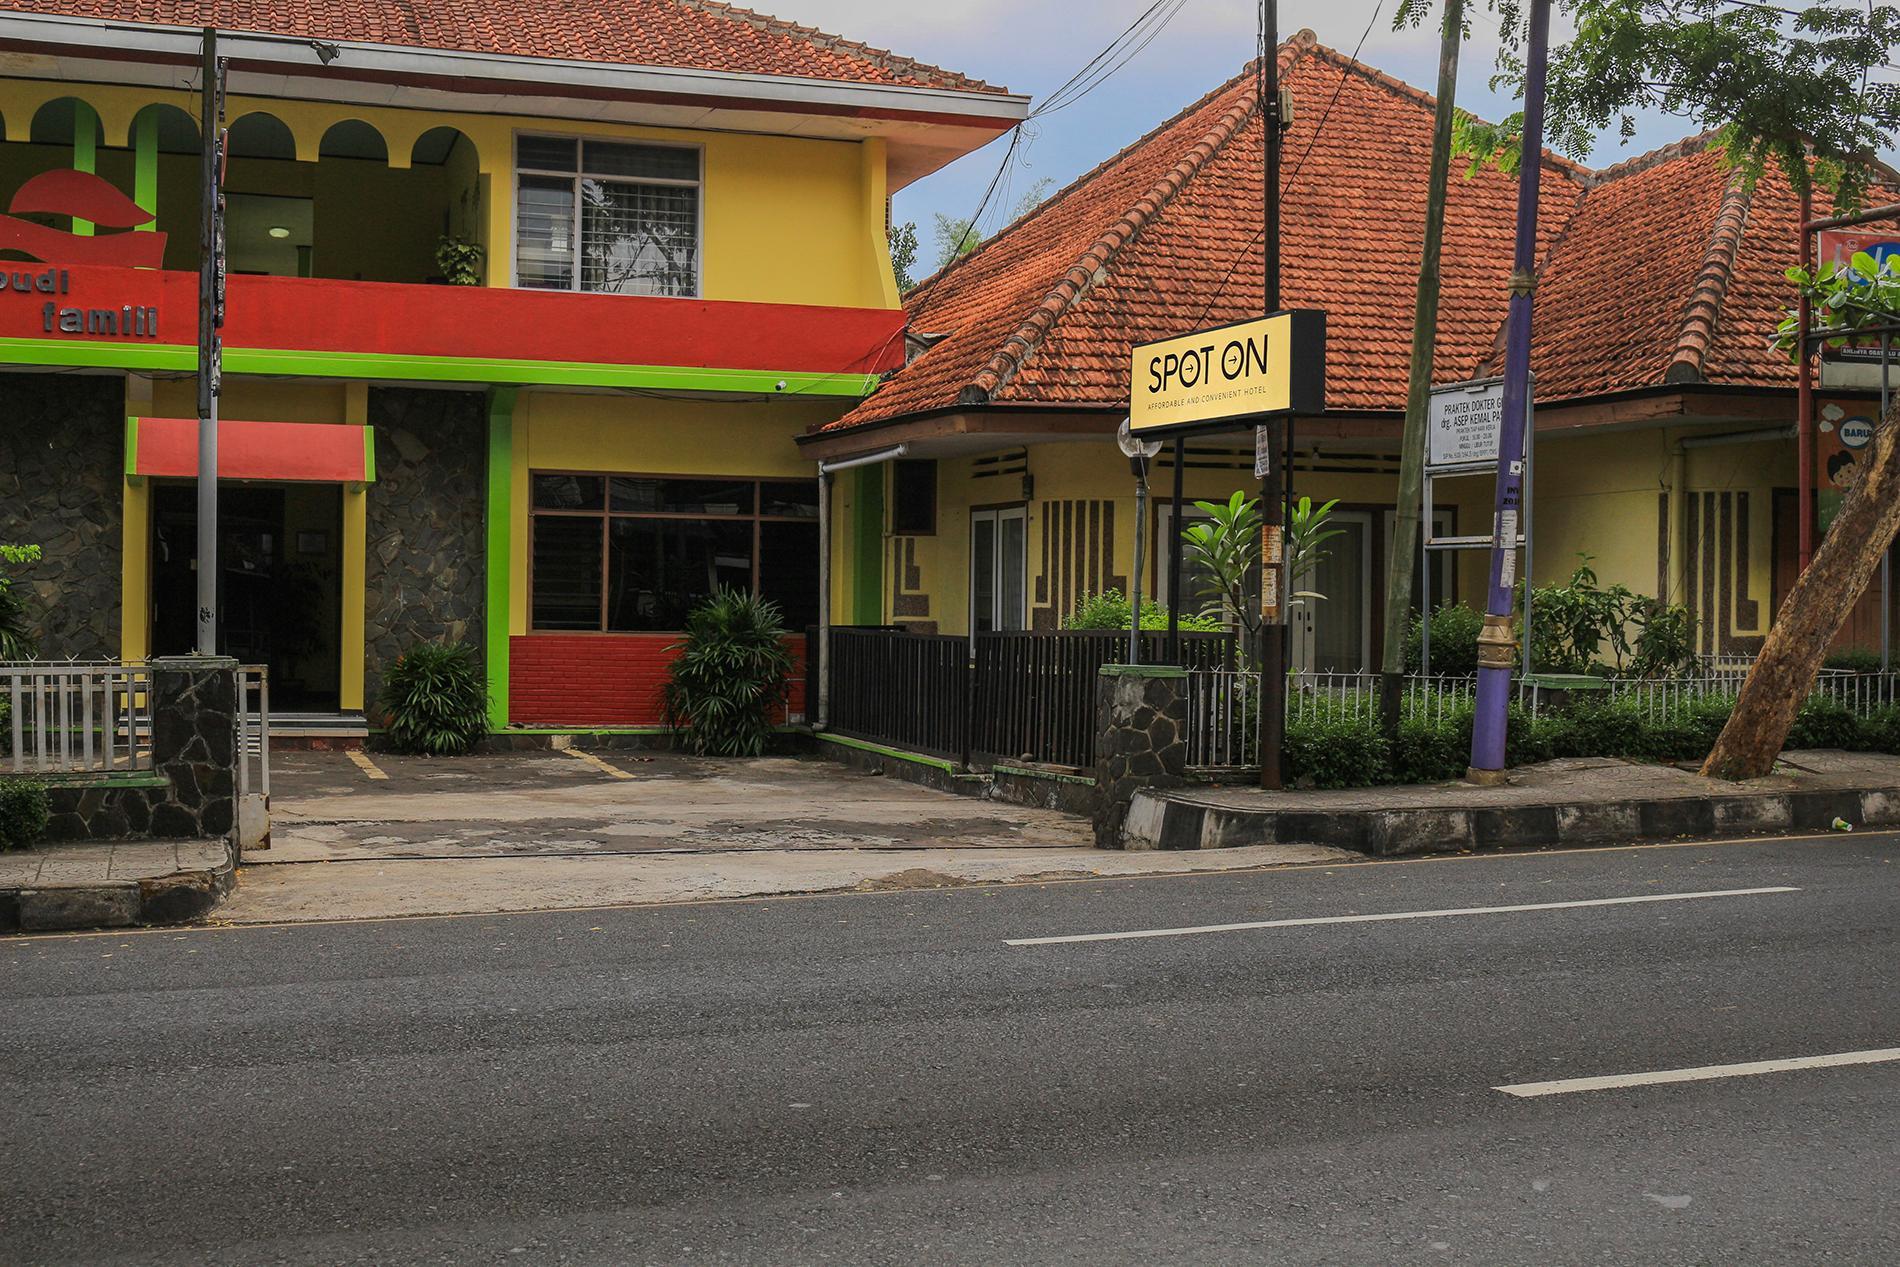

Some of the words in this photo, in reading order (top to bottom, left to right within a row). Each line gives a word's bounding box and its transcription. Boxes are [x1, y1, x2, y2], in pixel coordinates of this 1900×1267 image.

[1148, 345, 1215, 394] SPOT
[1221, 334, 1269, 381] ON
[1147, 398, 1185, 410] AFFORDABLE
[1187, 396, 1200, 405] AND
[1201, 389, 1242, 403] CONVENIENT
[1244, 386, 1267, 396] HOTEL
[1444, 402, 1471, 415] PRAKTEK
[1472, 398, 1496, 412] DOKTER
[1453, 414, 1469, 427] ASEP
[1470, 412, 1491, 425] KEMAL
